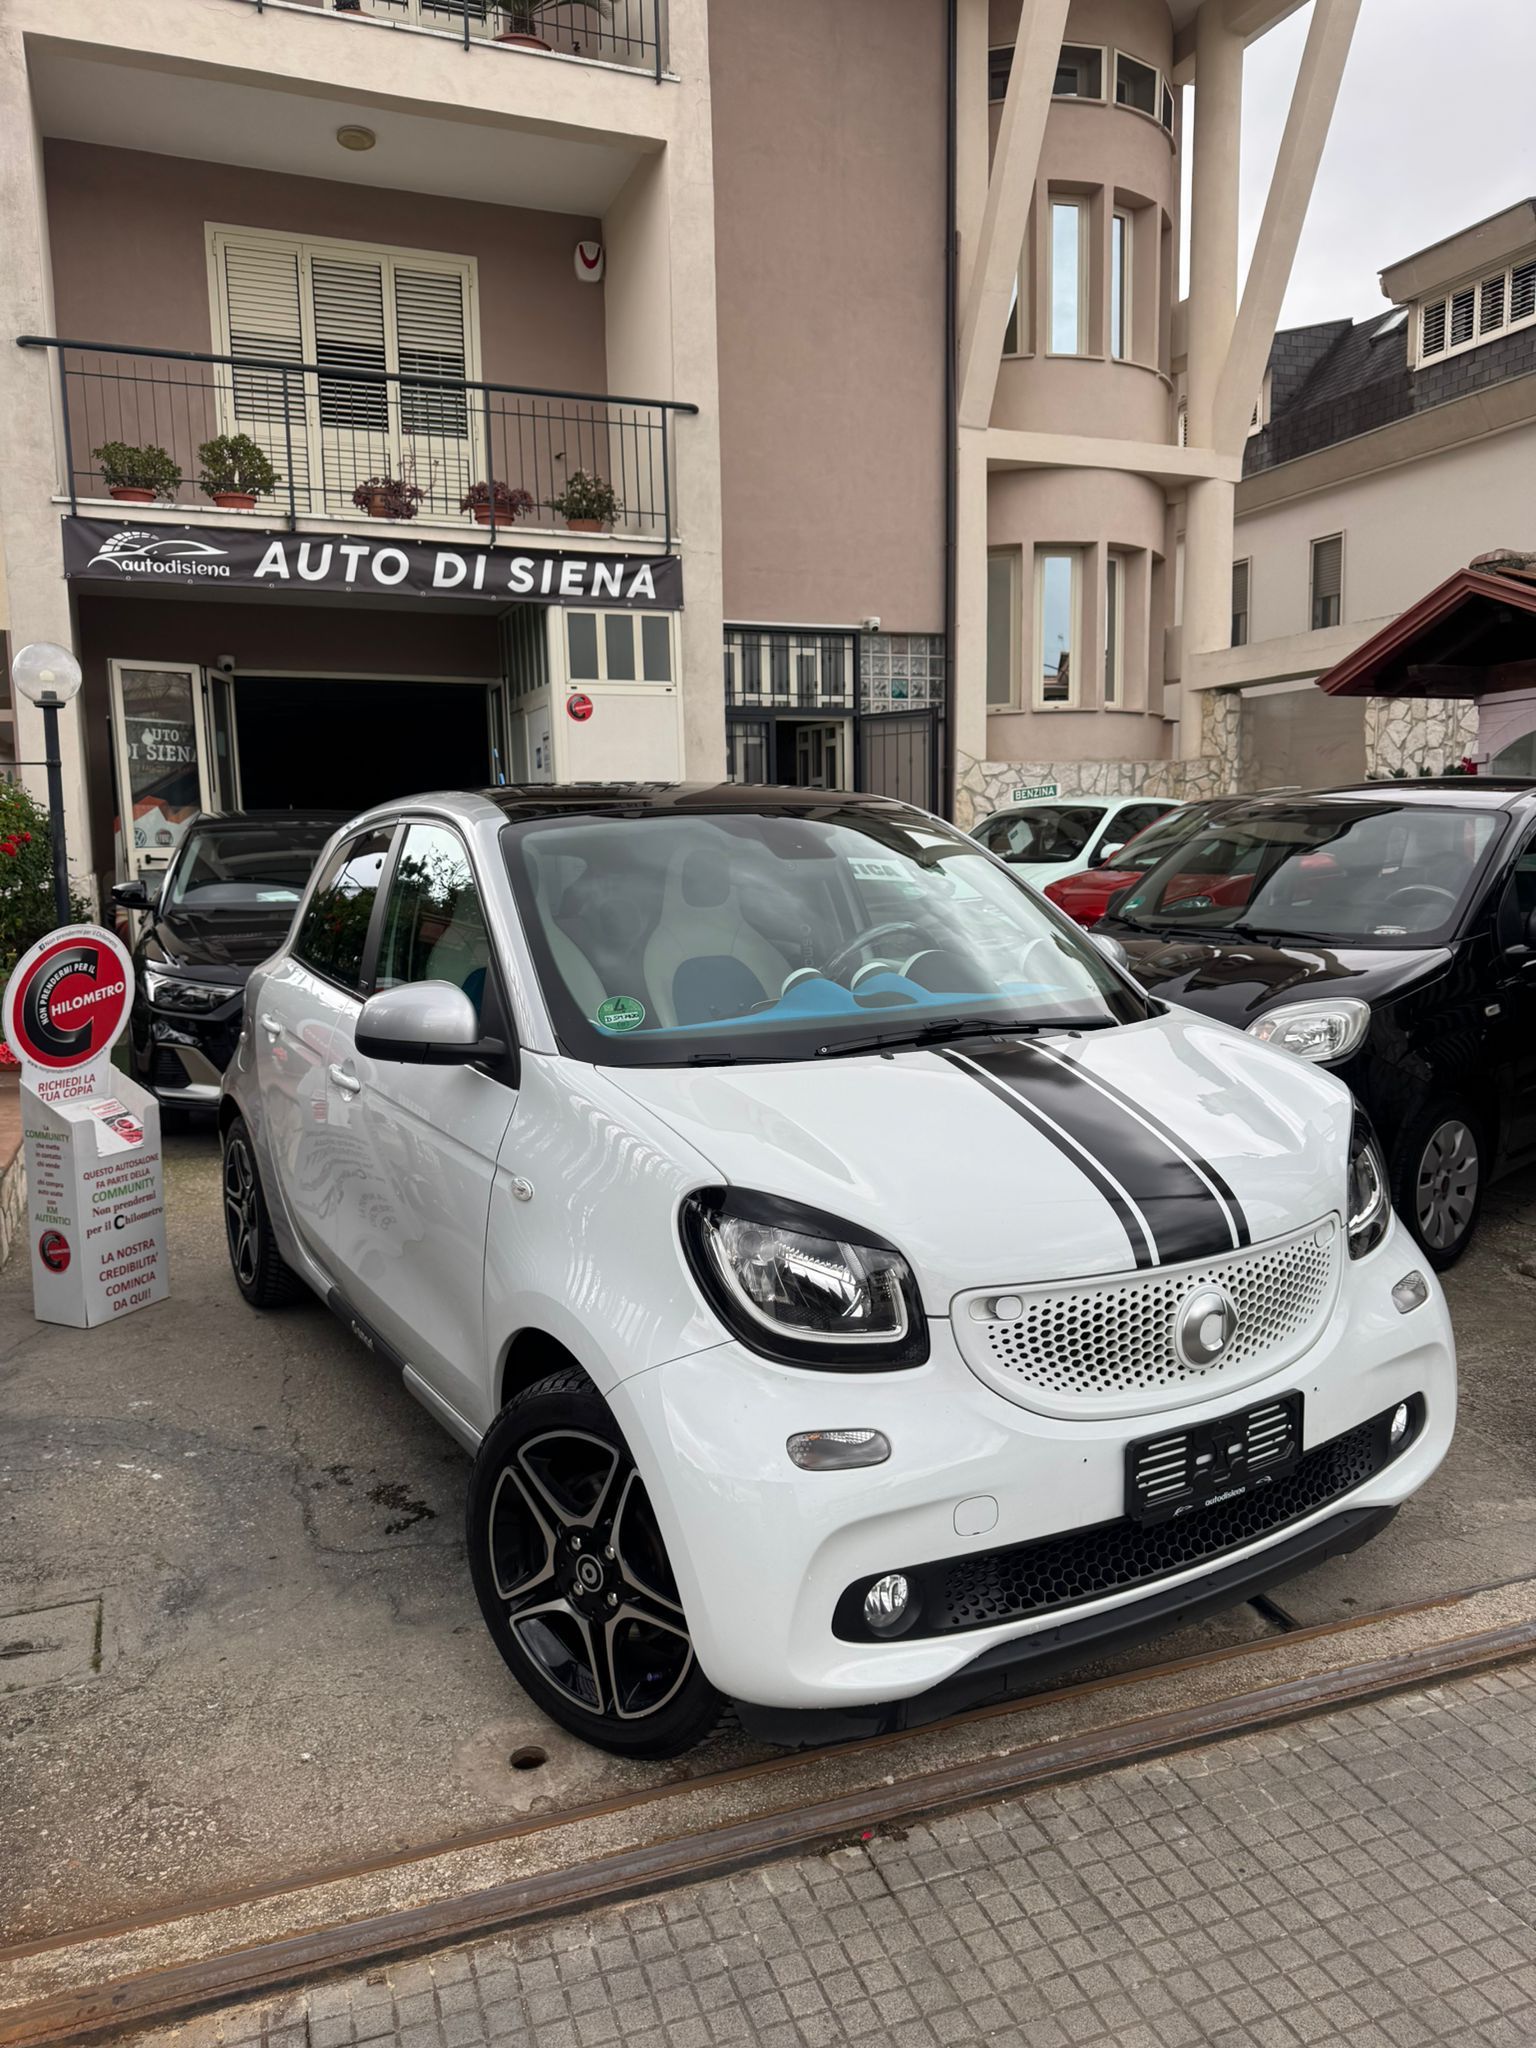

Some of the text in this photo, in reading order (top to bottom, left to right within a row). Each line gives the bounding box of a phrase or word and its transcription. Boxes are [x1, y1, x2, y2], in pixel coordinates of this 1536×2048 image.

[121, 558, 230, 577] autodisiena
[253, 541, 656, 599] AUTO DI SIENA
[1015, 787, 1055, 800] BENZINA
[40, 962, 96, 1026] NON PRENDERMI PER IL
[38, 1073, 96, 1093] RICHIEDI LA
[40, 1084, 93, 1102] TUA COPIA
[25, 1129, 70, 1143] COMMUNITY
[83, 1152, 159, 1181] QUESTO AUTOSALONE
[96, 1167, 150, 1189] FA PARTE DELLA
[92, 1176, 155, 1204] COMMUNITY
[47, 1206, 58, 1215] KM
[92, 1190, 156, 1218] Non prendermi
[35, 1212, 71, 1226] AUTENTICI
[86, 1206, 163, 1239] per il Chilometro
[101, 1238, 155, 1265] LA NOSTRA
[99, 1251, 159, 1282] CREDIBILITA'
[106, 1271, 156, 1296] COMINCIA
[113, 1288, 151, 1311] DA QUI!
